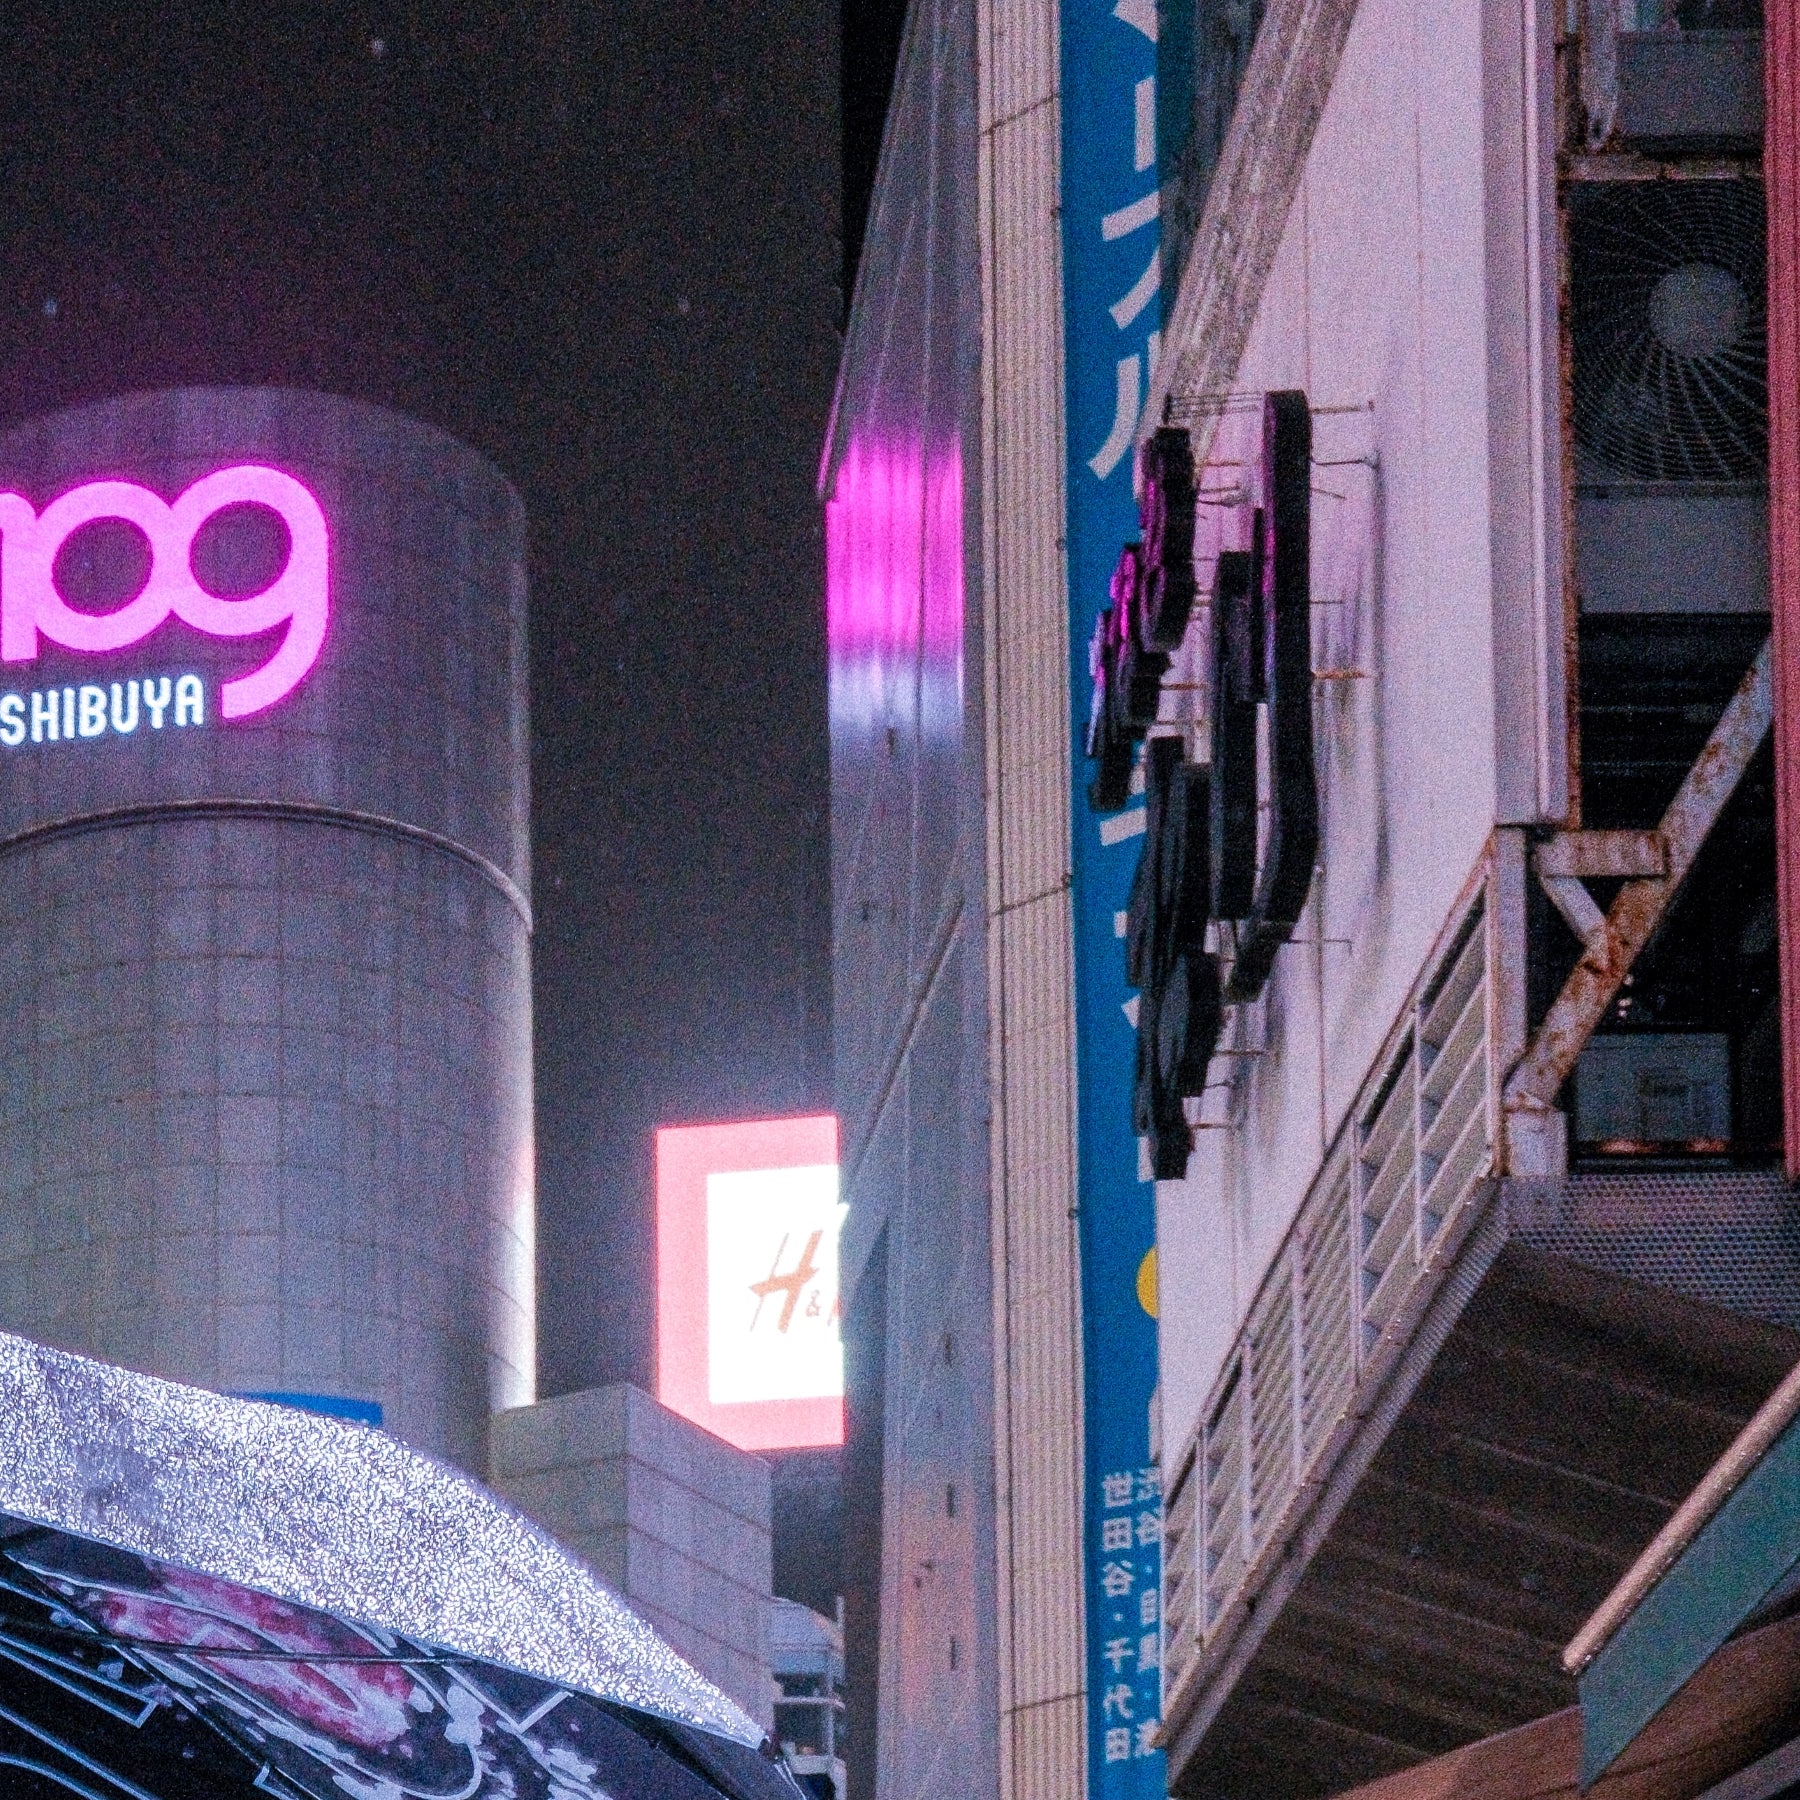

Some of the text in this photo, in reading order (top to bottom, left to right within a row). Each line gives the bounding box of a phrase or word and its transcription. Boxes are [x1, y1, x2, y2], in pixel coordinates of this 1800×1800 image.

[748, 1229, 838, 1334] H&
[1101, 1471, 1134, 1763] 世田谷・千代田
